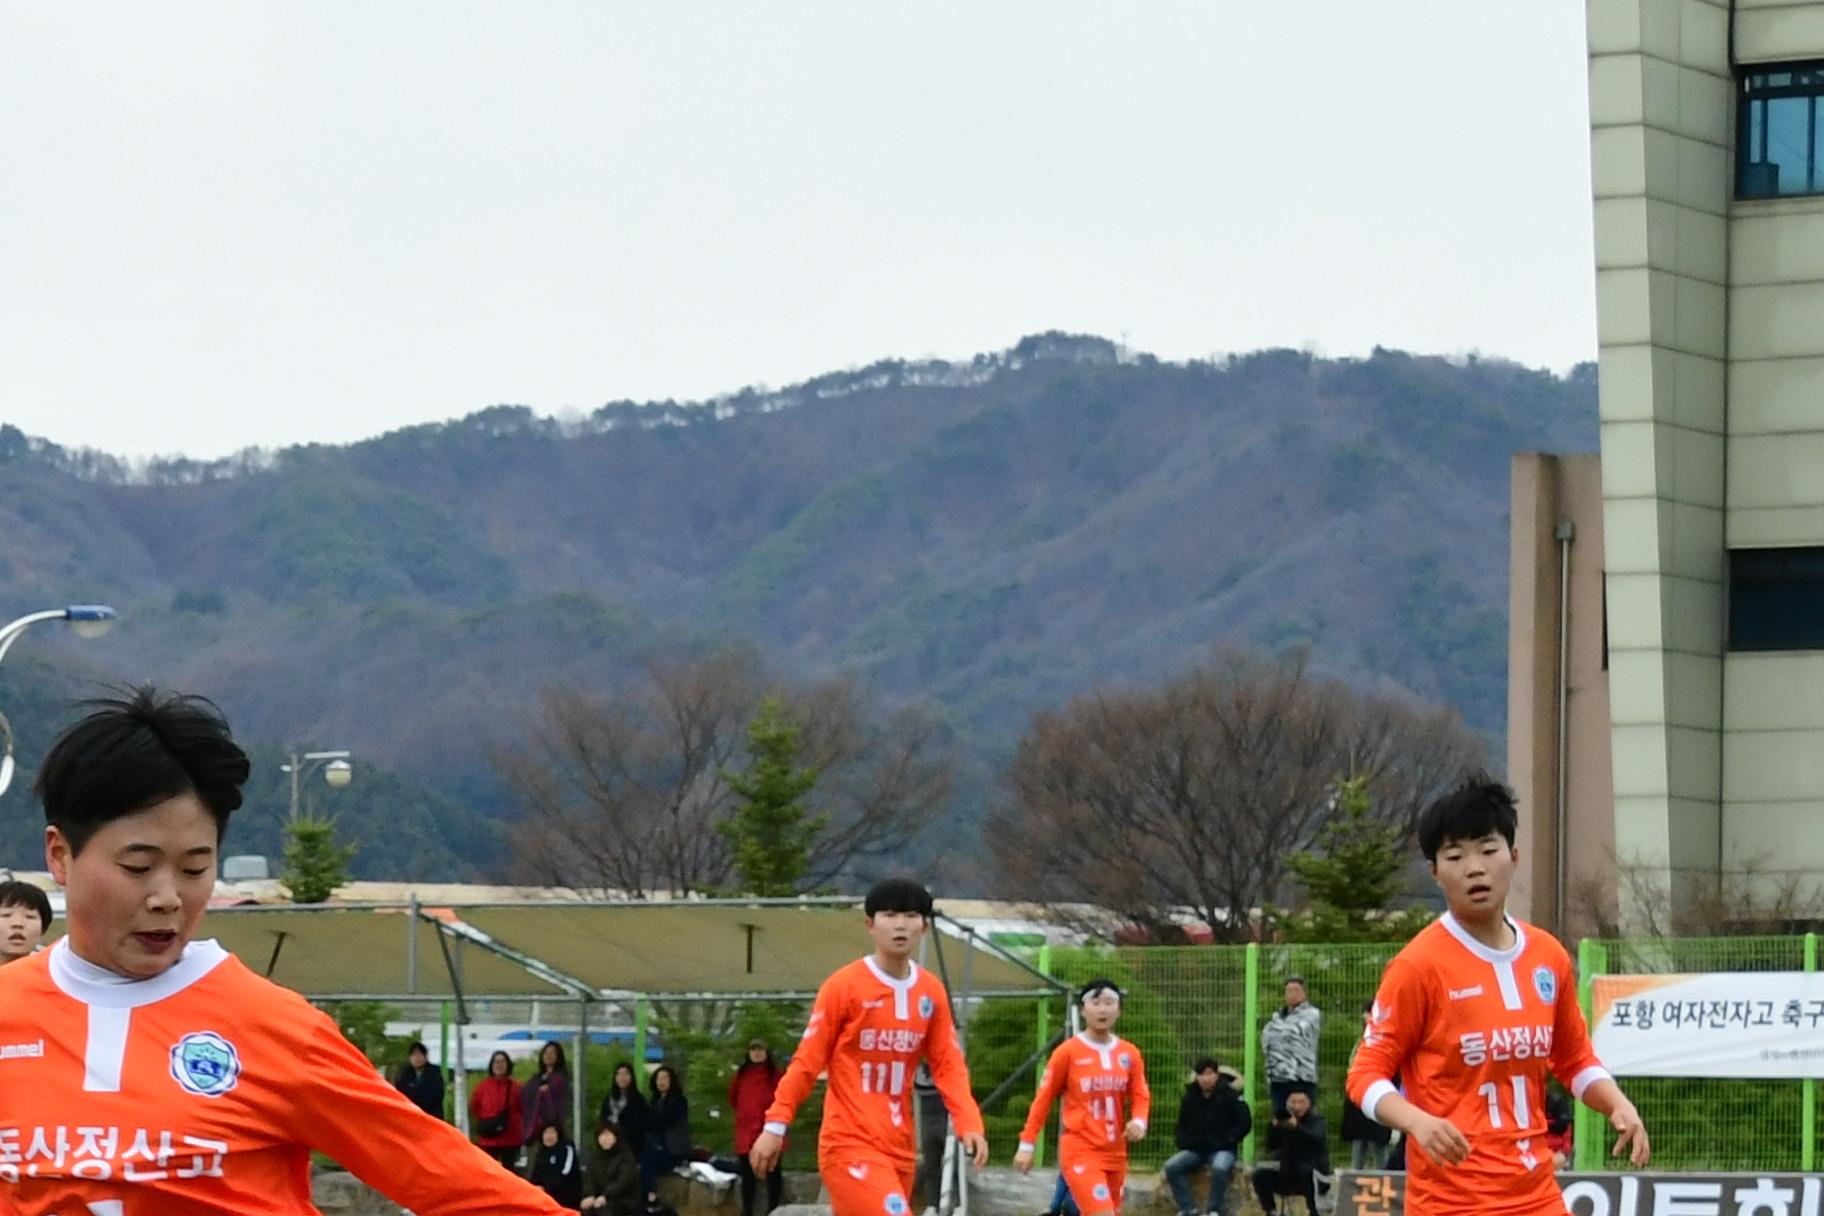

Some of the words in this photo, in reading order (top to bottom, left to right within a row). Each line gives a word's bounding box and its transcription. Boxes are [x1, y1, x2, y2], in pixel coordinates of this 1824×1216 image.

[1612, 1001, 1655, 1030] 포항
[1663, 1000, 1774, 1030] 여자전자고
[1459, 1025, 1553, 1066] 동산정산
